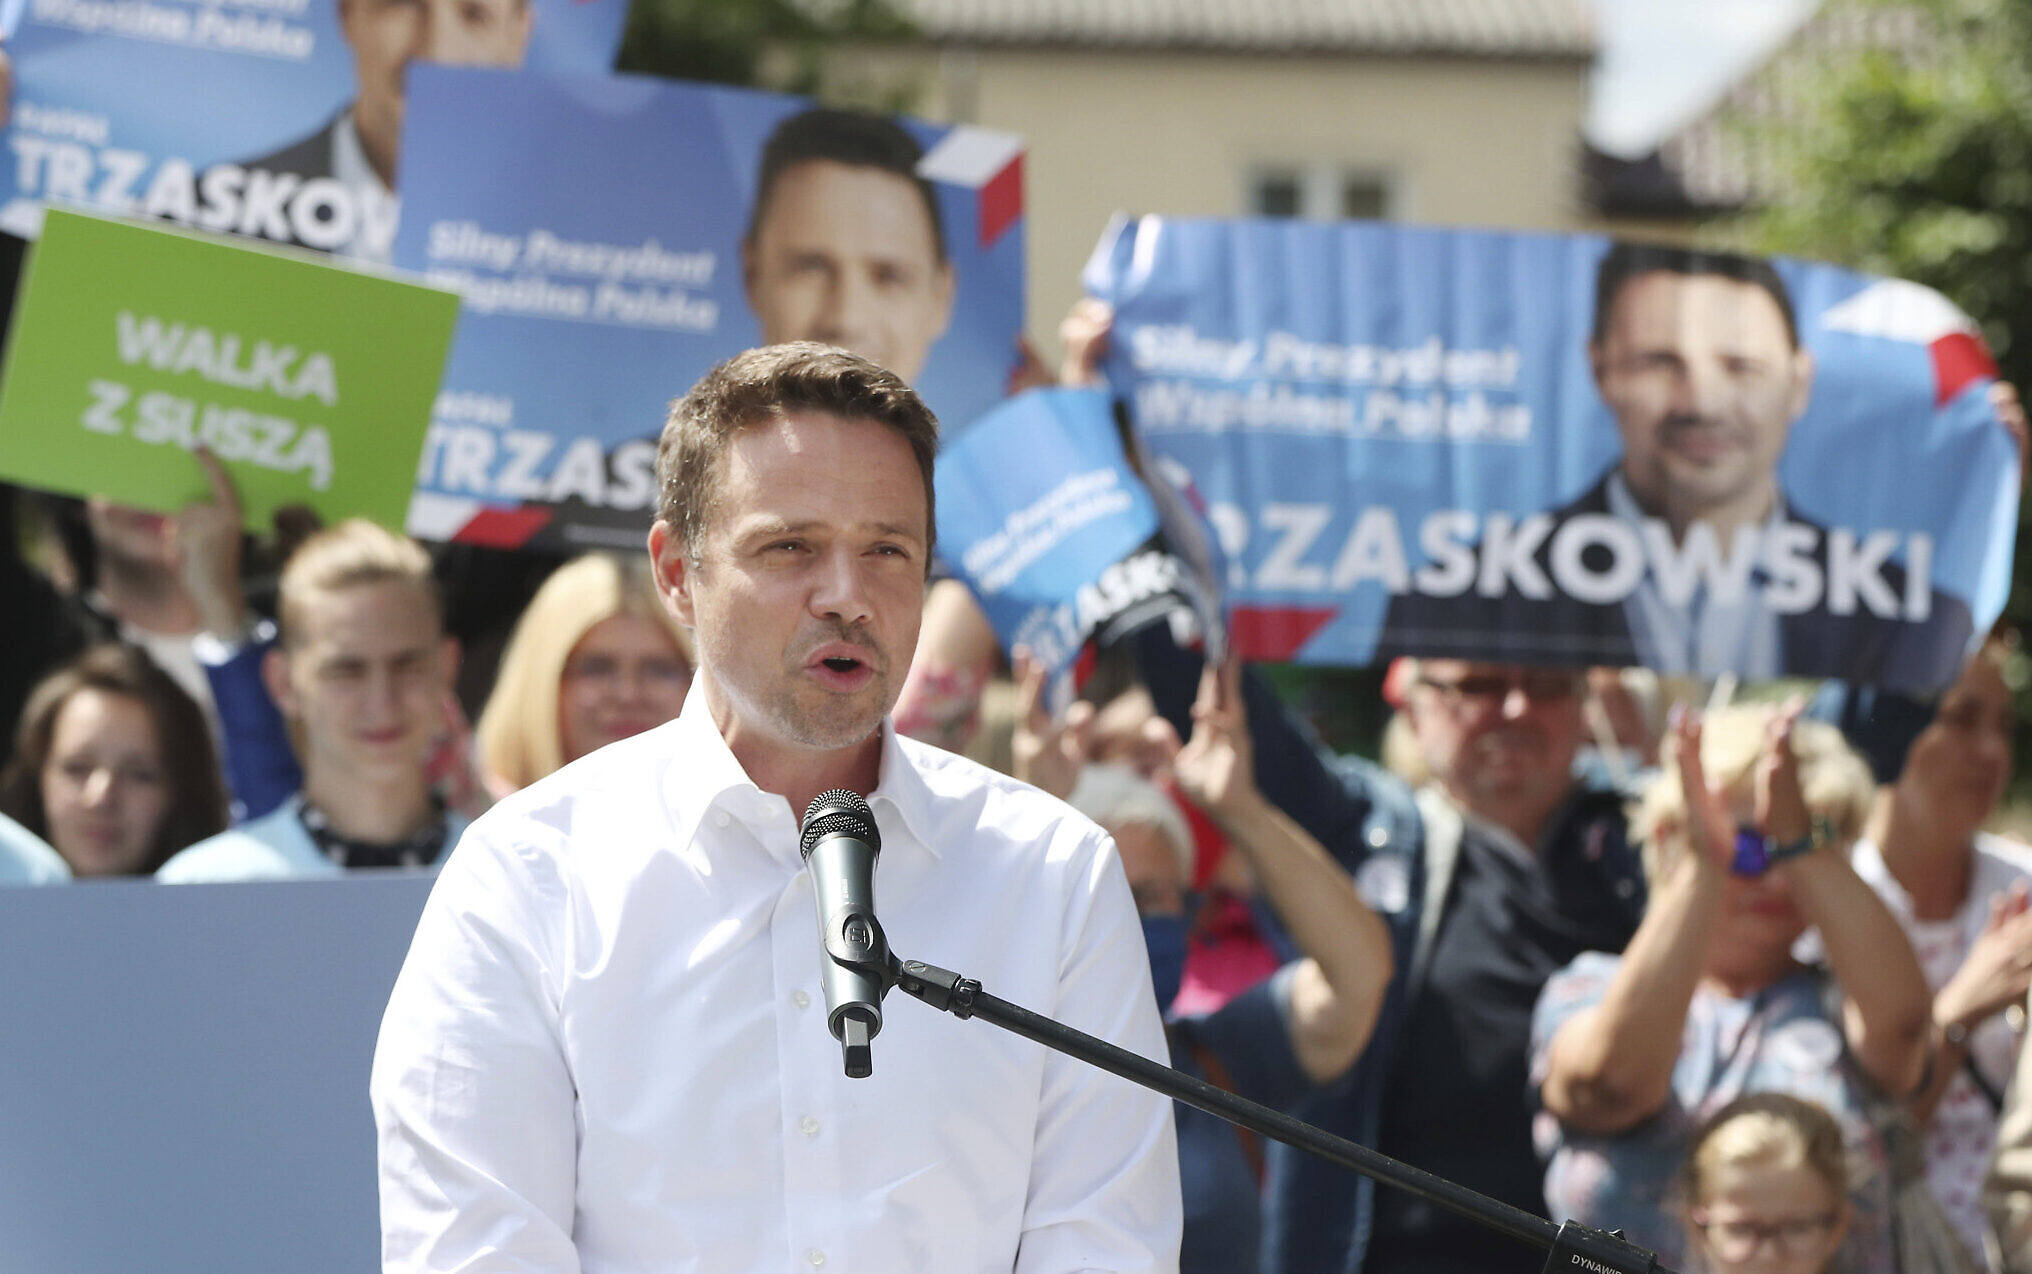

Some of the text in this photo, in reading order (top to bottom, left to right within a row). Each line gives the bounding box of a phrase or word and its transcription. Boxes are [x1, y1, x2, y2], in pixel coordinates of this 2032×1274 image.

[115, 311, 337, 408] WALKA
[80, 379, 334, 491] Z SUSZĄ
